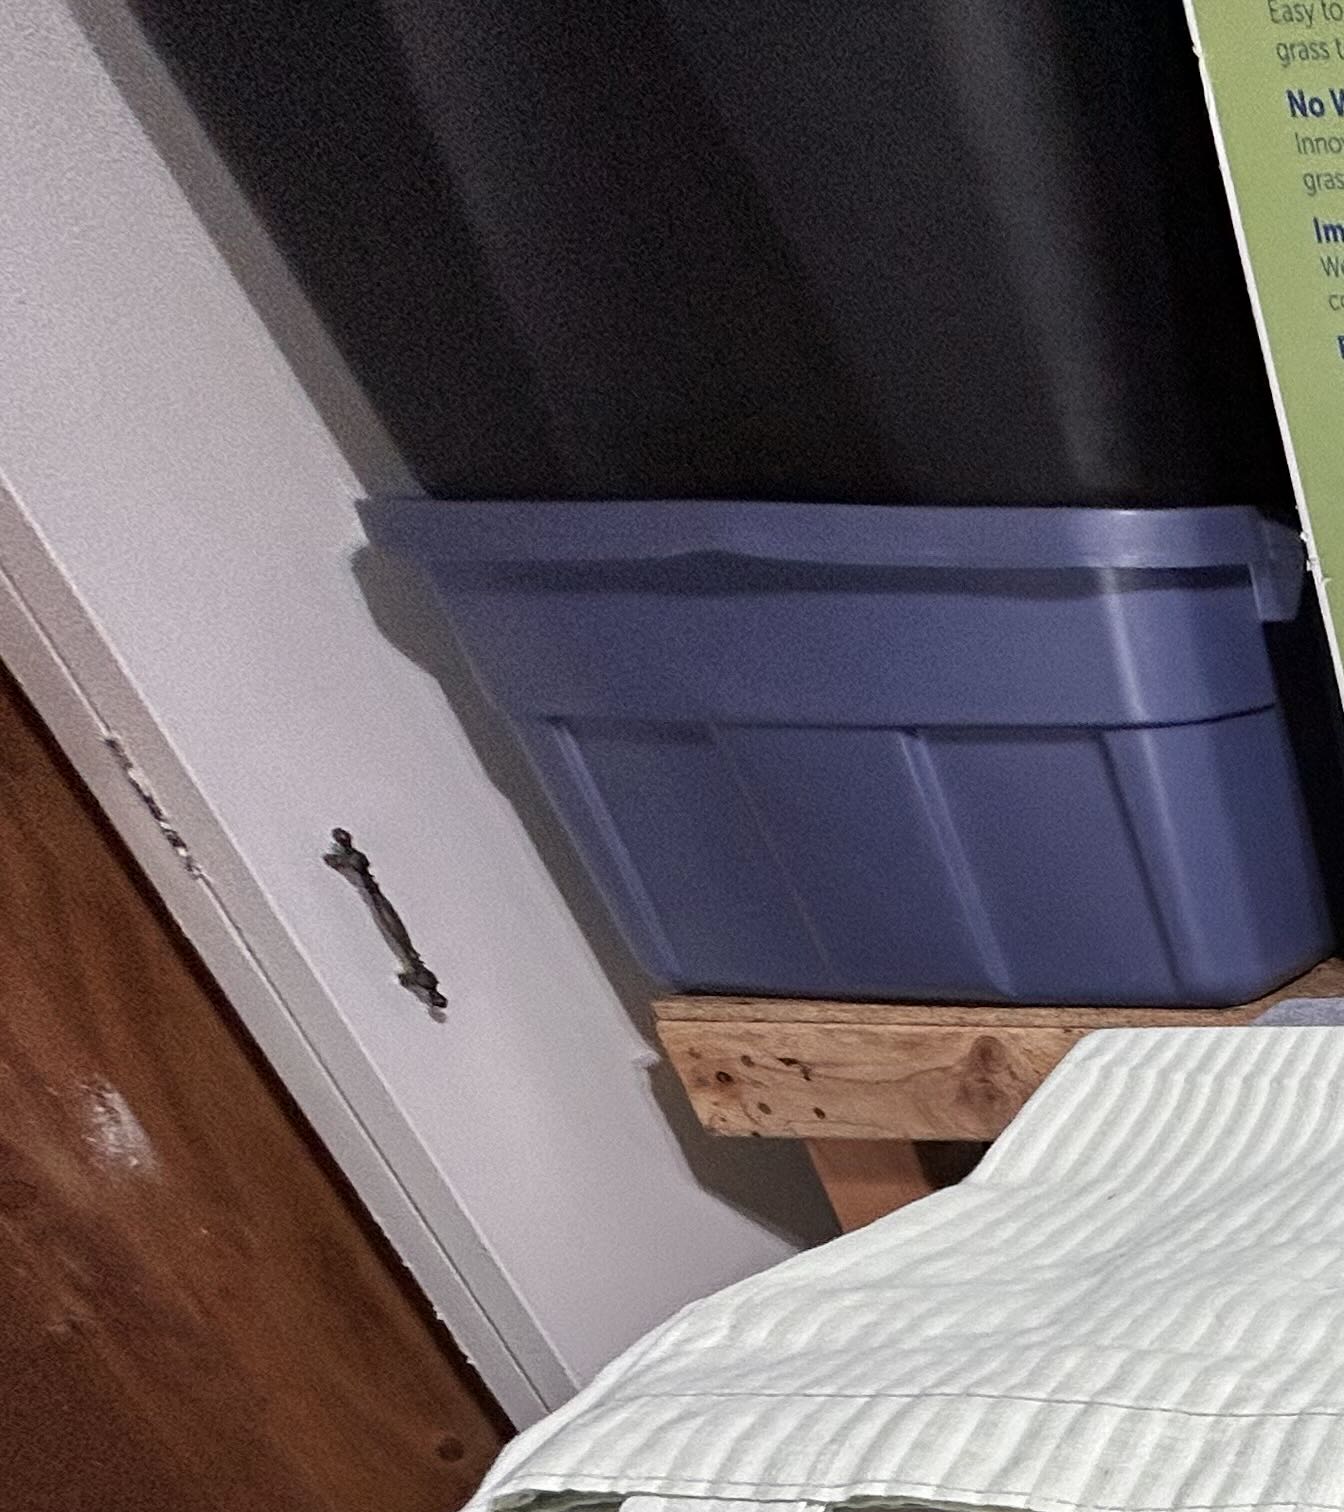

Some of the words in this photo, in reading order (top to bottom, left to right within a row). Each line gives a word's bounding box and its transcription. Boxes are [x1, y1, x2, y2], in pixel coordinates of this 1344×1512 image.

[1269, 0, 1314, 28] Easy
[1323, 0, 1343, 21] to
[1276, 40, 1331, 68] grass
[1286, 88, 1326, 118] No
